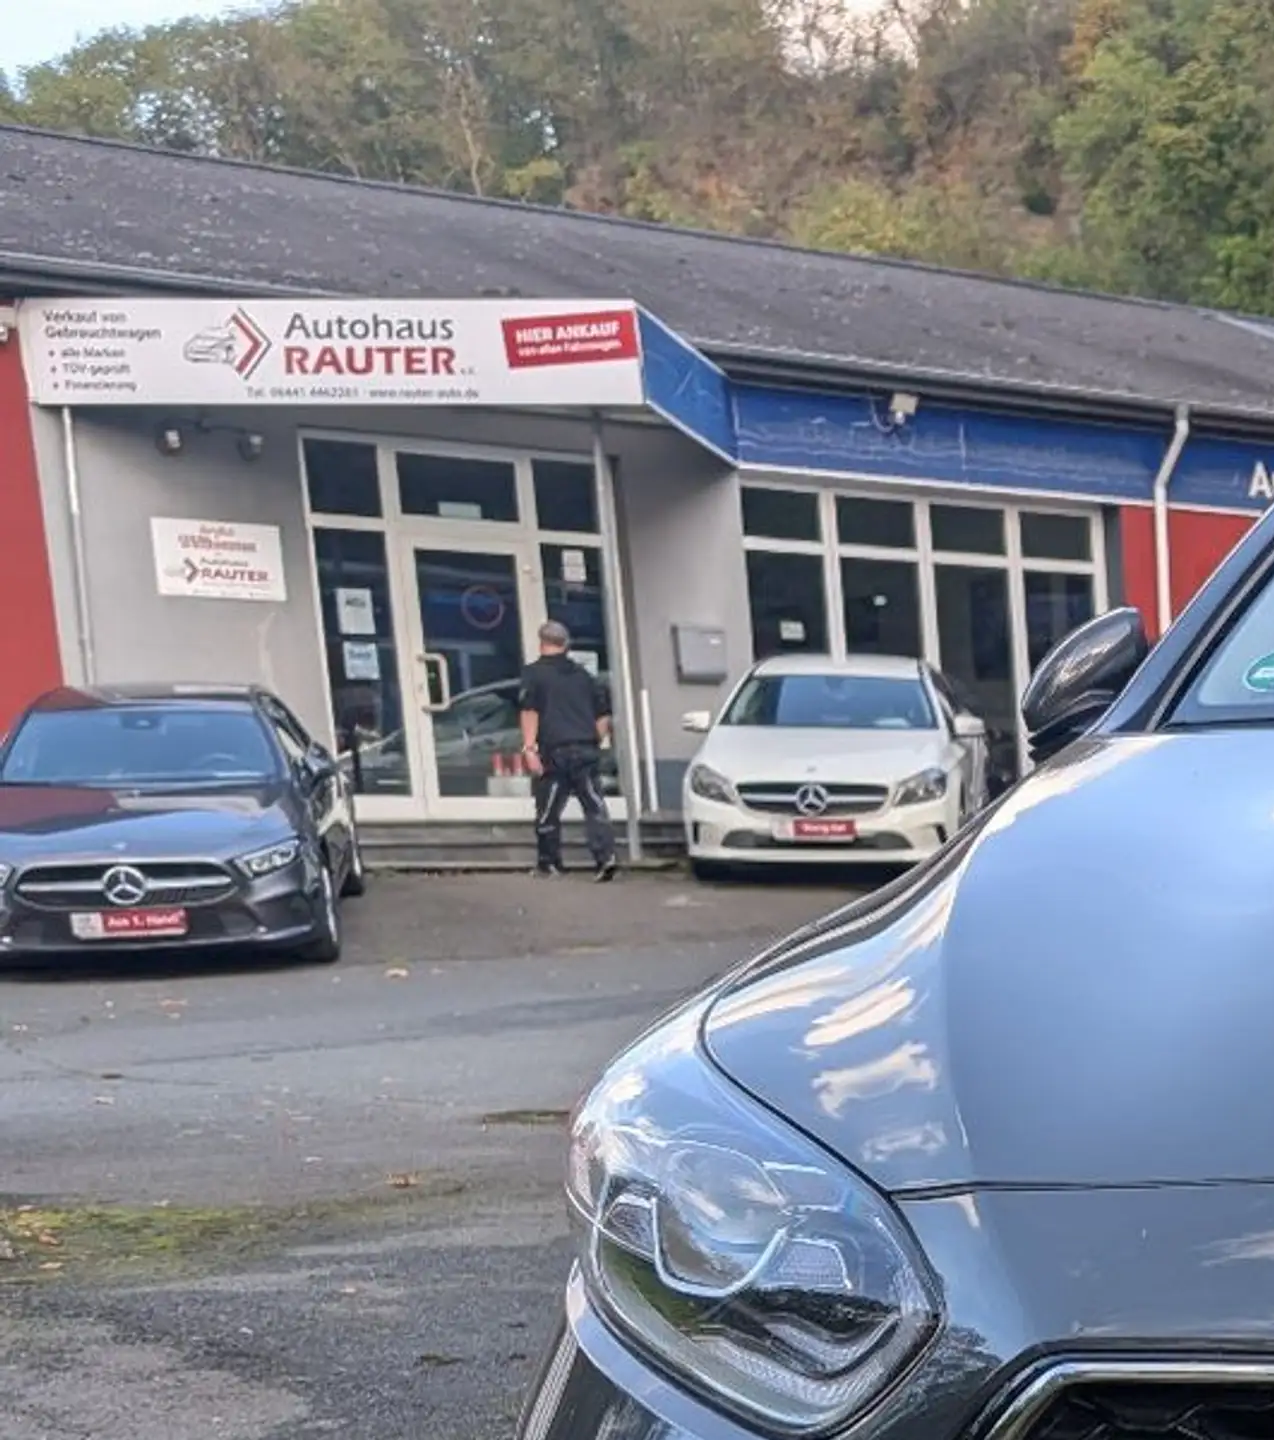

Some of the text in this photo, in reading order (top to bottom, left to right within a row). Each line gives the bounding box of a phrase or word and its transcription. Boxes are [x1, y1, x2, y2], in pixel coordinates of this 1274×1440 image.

[284, 312, 454, 340] Autohaus
[516, 320, 619, 344] HIER ANKAUF
[284, 346, 456, 375] RAUTER
[201, 567, 269, 582] RAUTER
